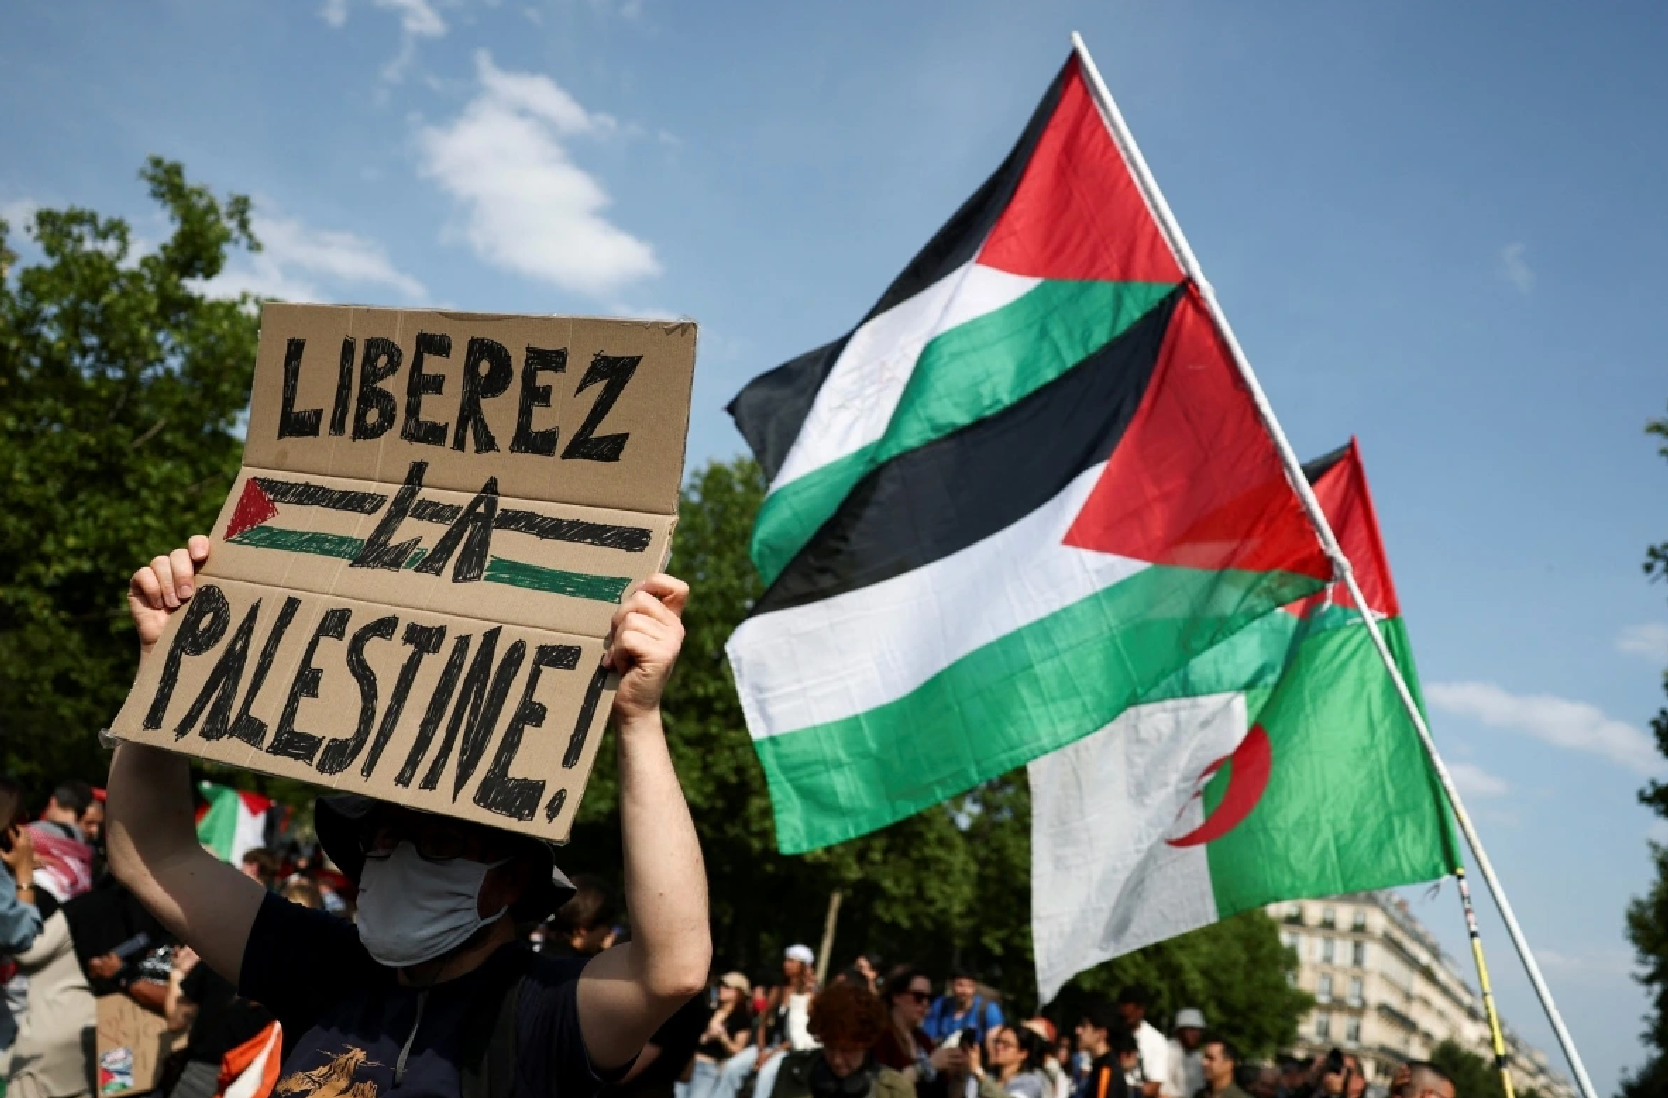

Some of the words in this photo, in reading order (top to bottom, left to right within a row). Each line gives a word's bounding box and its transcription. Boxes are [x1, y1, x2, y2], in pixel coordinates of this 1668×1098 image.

[278, 331, 643, 462] LIBEREZ
[350, 460, 499, 583] LA
[143, 584, 608, 823] PALESTINE!
